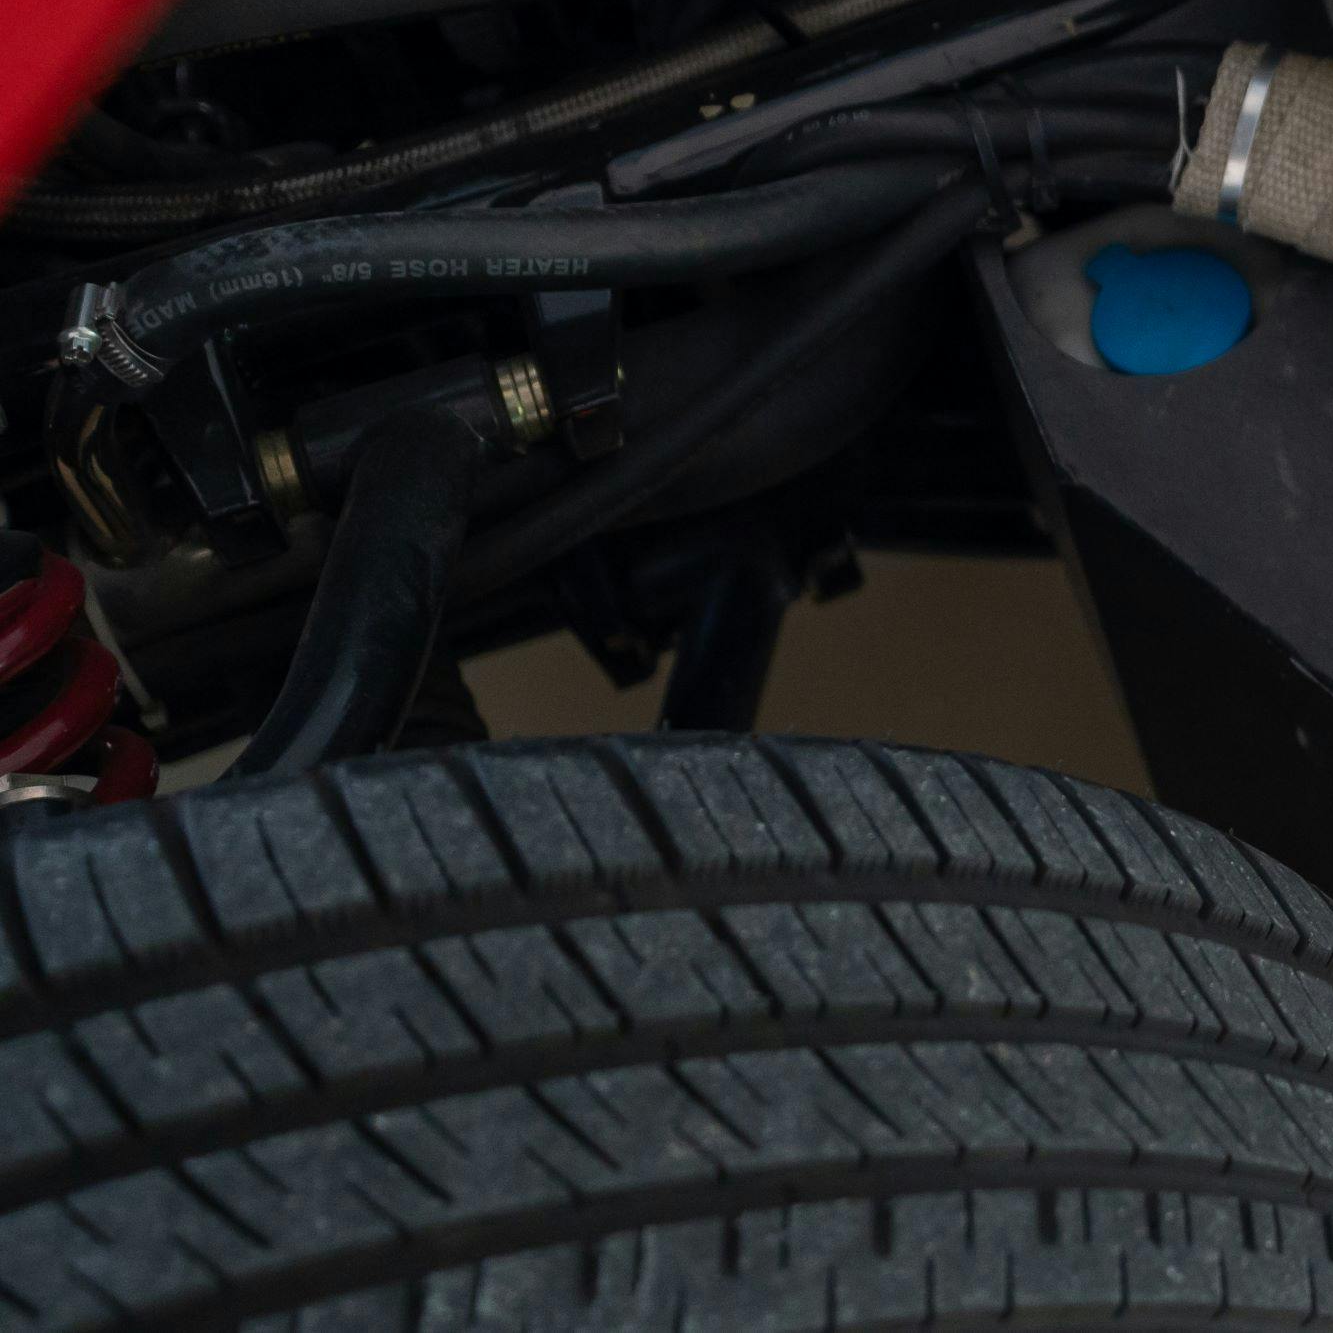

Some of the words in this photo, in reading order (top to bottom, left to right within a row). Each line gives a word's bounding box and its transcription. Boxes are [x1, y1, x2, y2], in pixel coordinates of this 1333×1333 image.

[321, 261, 372, 283] 5/8"
[390, 258, 468, 278] HOSE
[486, 257, 588, 276] HEATER
[208, 266, 304, 302] (16mm)
